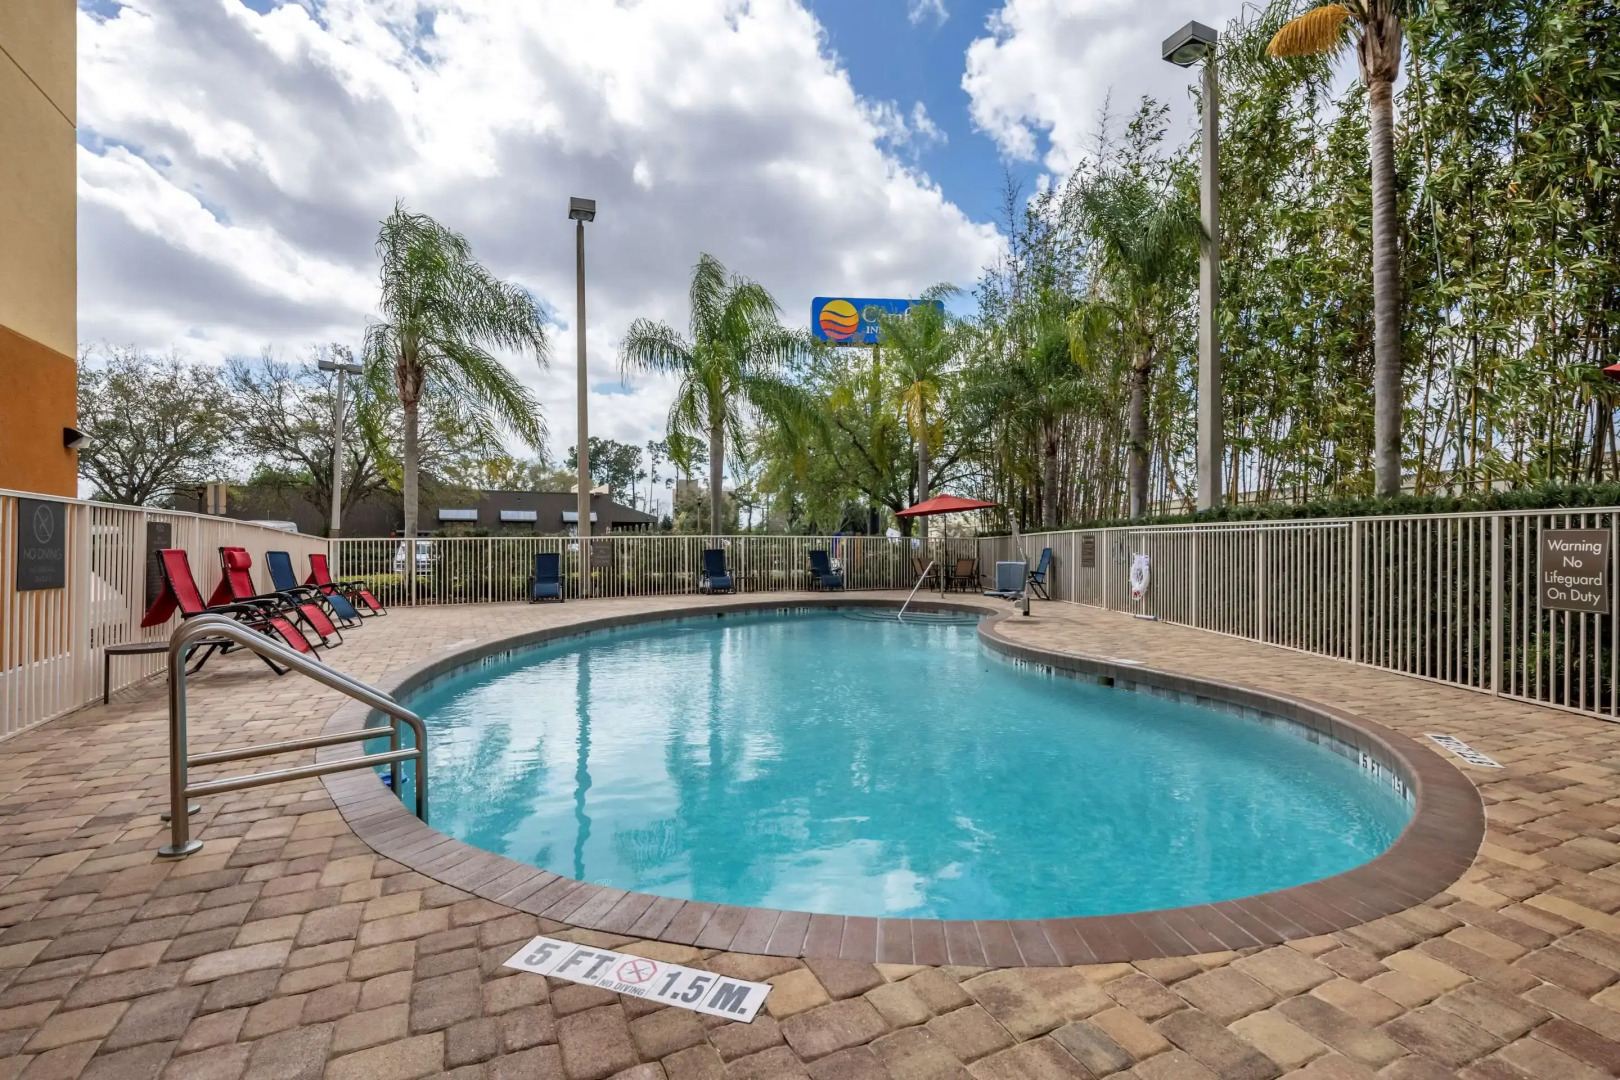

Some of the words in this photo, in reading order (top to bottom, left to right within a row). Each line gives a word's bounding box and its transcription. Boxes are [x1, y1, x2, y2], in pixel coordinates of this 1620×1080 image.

[23, 548, 36, 560] NO
[37, 548, 62, 560] DIVING
[1547, 539, 1602, 555] Warning
[1563, 556, 1583, 568] No
[1544, 570, 1602, 588] Lifeguard
[1547, 587, 1566, 600] On
[1570, 589, 1601, 606] Duty
[524, 942, 562, 967] 5
[556, 950, 616, 980] FT.
[657, 970, 711, 1003] 1.5
[707, 982, 752, 1015] M.
[599, 979, 614, 988] NO
[614, 982, 646, 996] DIVING
